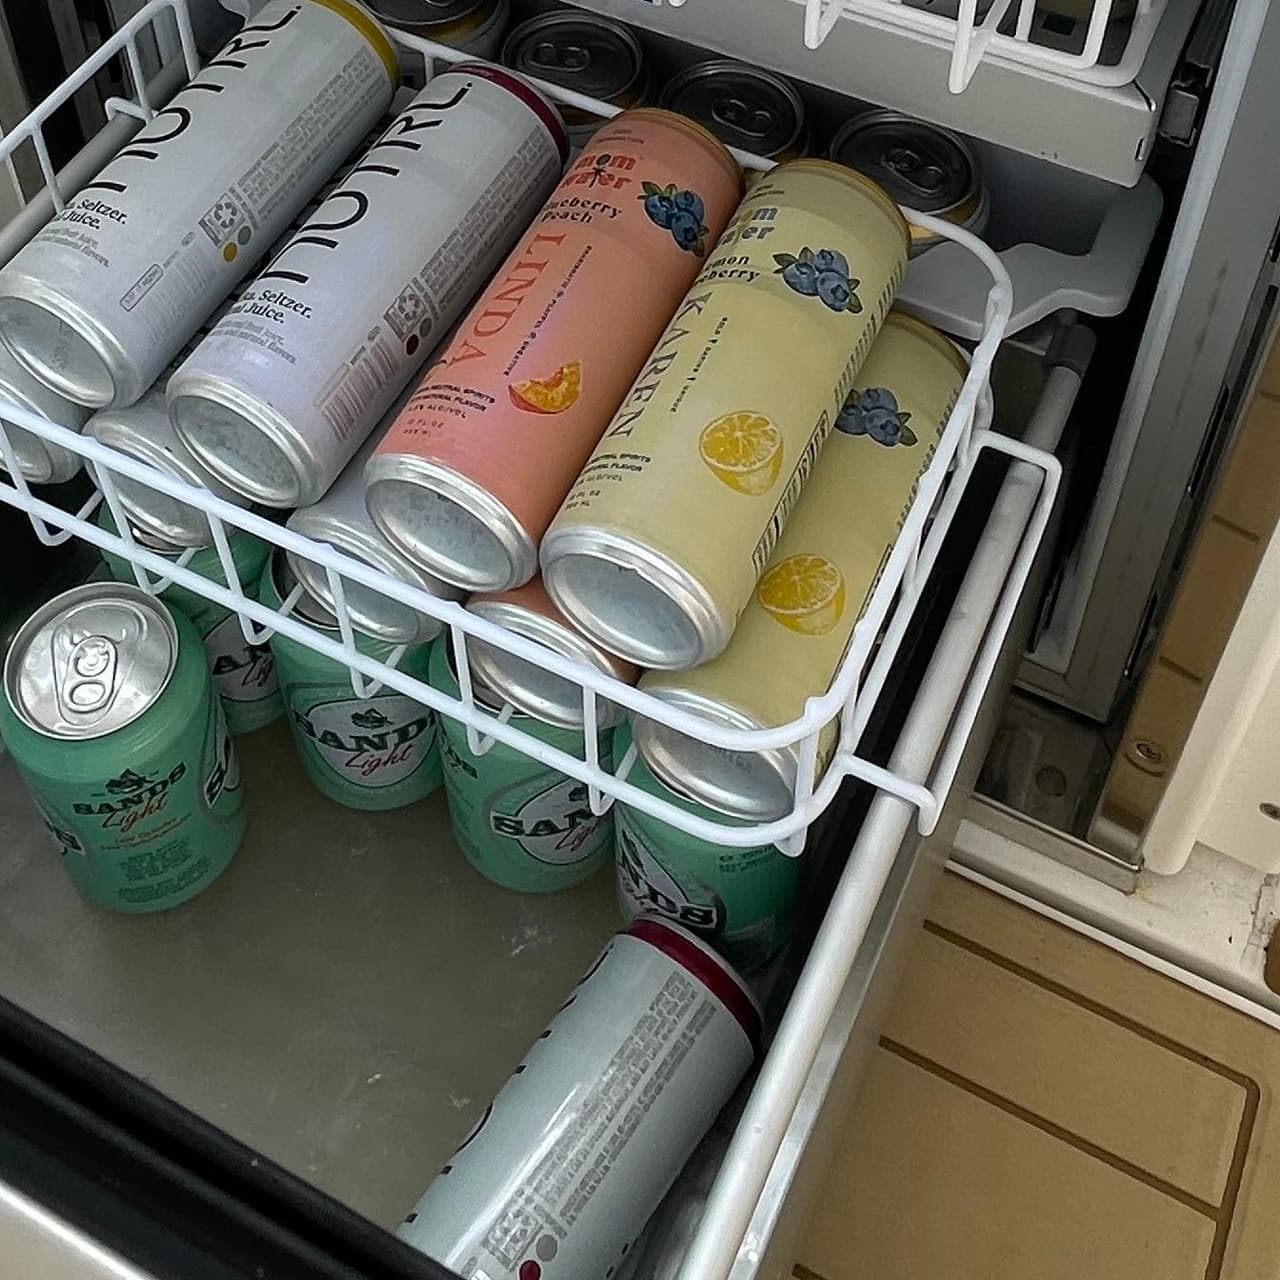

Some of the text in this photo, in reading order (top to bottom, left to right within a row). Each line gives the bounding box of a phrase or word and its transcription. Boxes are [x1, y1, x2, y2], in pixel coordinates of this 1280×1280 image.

[447, 233, 567, 368] LINDA
[607, 292, 713, 438] KAREN
[345, 742, 413, 776] Light
[72, 762, 186, 814] SANDS
[102, 791, 169, 833] Light
